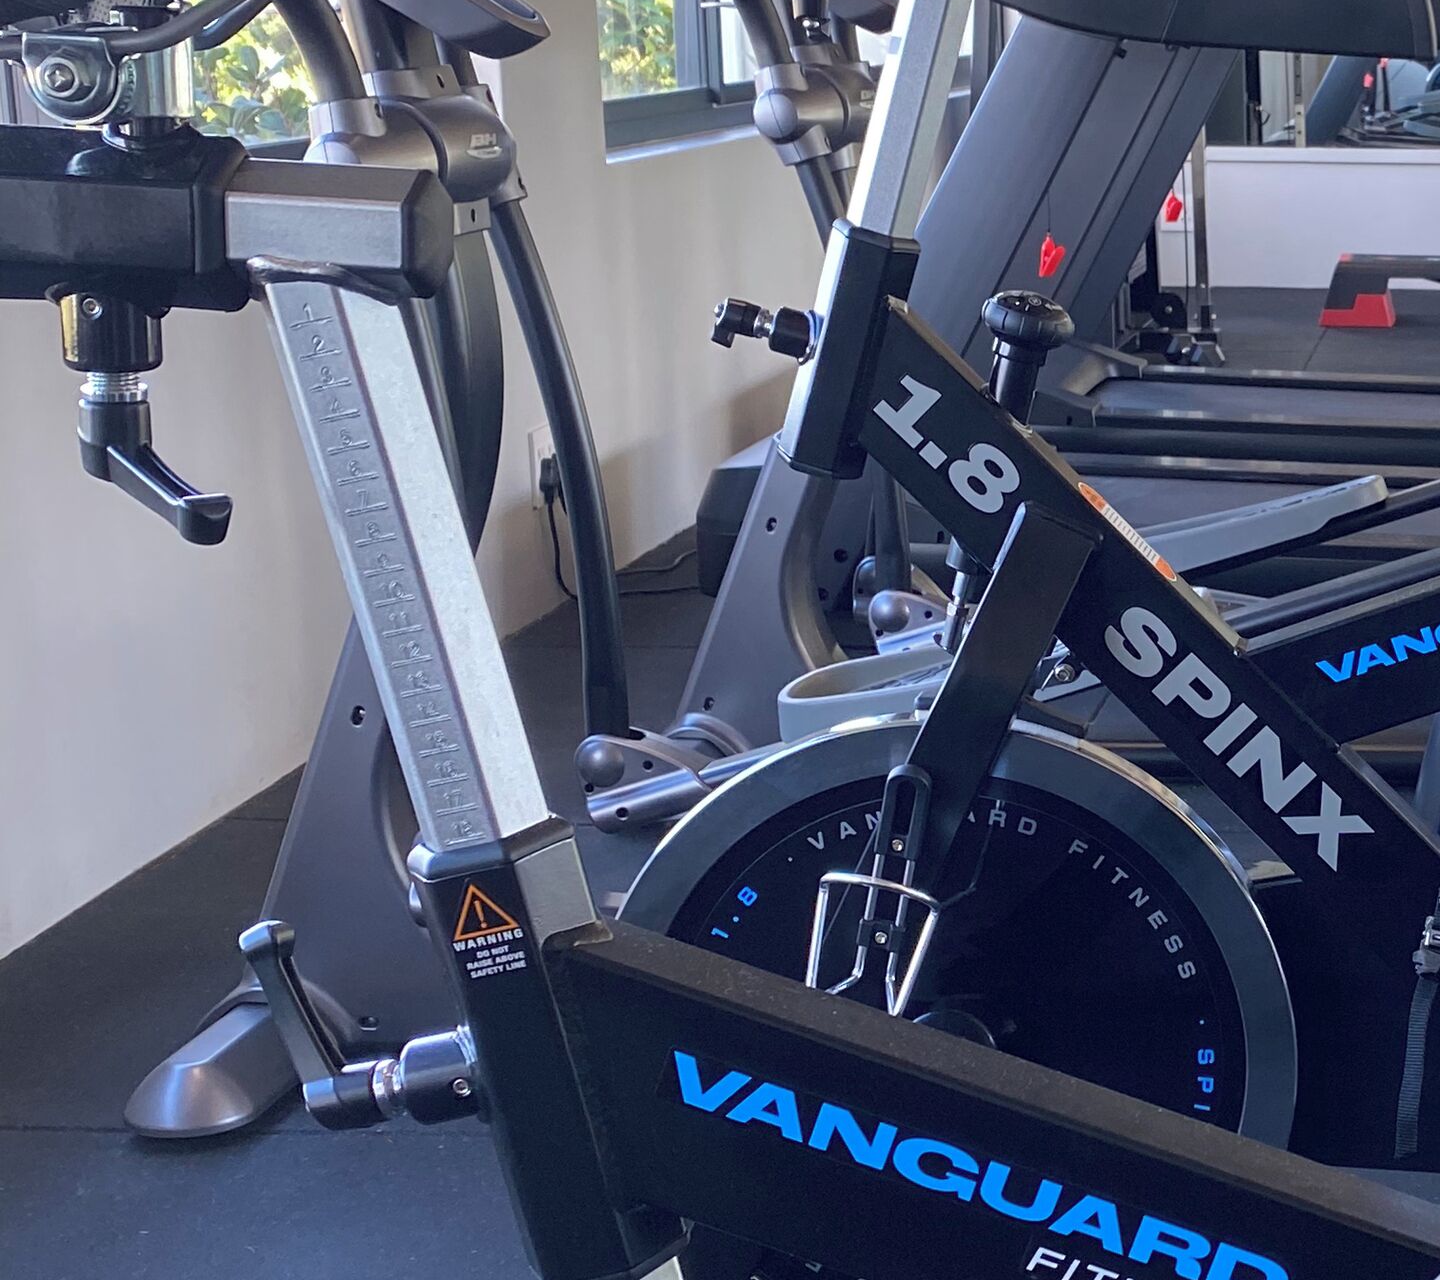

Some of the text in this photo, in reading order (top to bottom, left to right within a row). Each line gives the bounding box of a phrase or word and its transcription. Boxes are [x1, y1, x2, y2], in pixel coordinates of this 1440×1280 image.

[303, 302, 314, 321] 1
[312, 334, 325, 353] 2
[873, 375, 1021, 513] 1.8
[1105, 606, 1375, 873] SPINX
[807, 808, 1197, 980] VANRD FITNESS
[710, 886, 758, 939] 1.8
[453, 928, 524, 952] WARNING
[466, 951, 525, 971] RAISE ABOVE
[476, 945, 509, 959] DO NOT
[470, 960, 527, 979] SAFETY LINE
